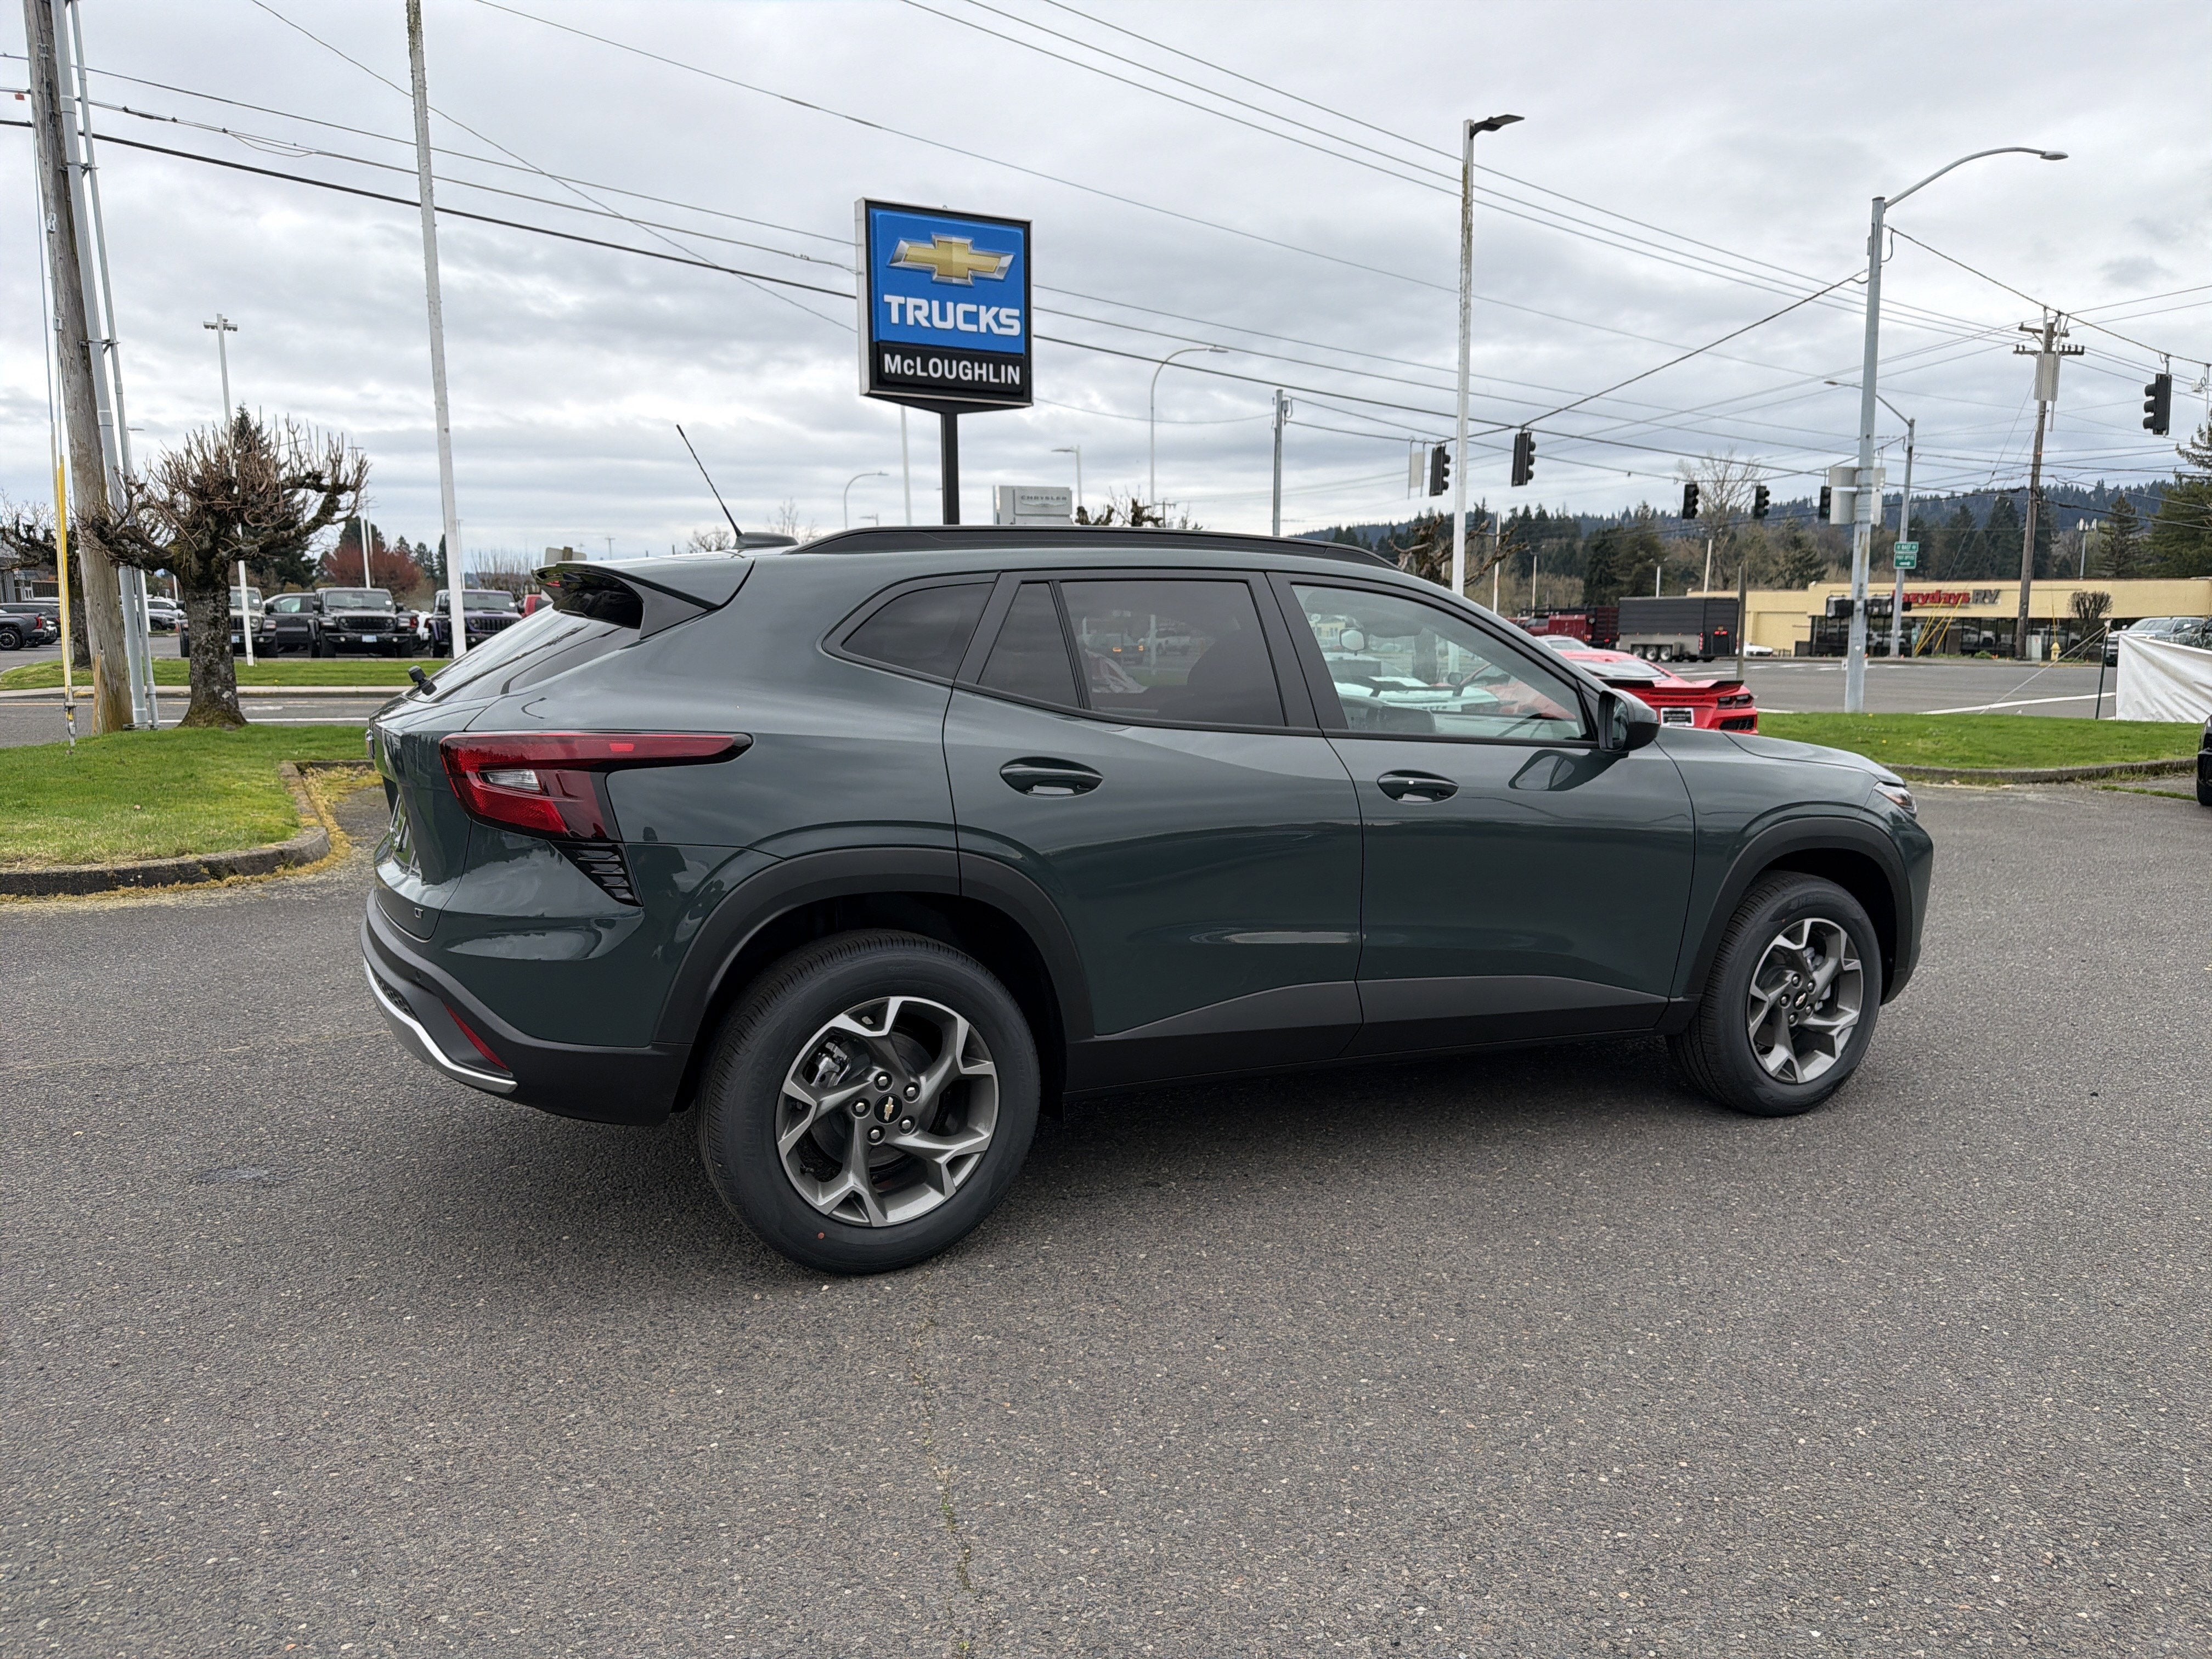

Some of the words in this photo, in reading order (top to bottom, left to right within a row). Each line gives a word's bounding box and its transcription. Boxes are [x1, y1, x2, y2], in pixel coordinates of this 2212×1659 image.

[884, 295, 1020, 336] TRUCKS
[884, 353, 1020, 385] McLOUGHLIN
[1892, 589, 1971, 605] azydays
